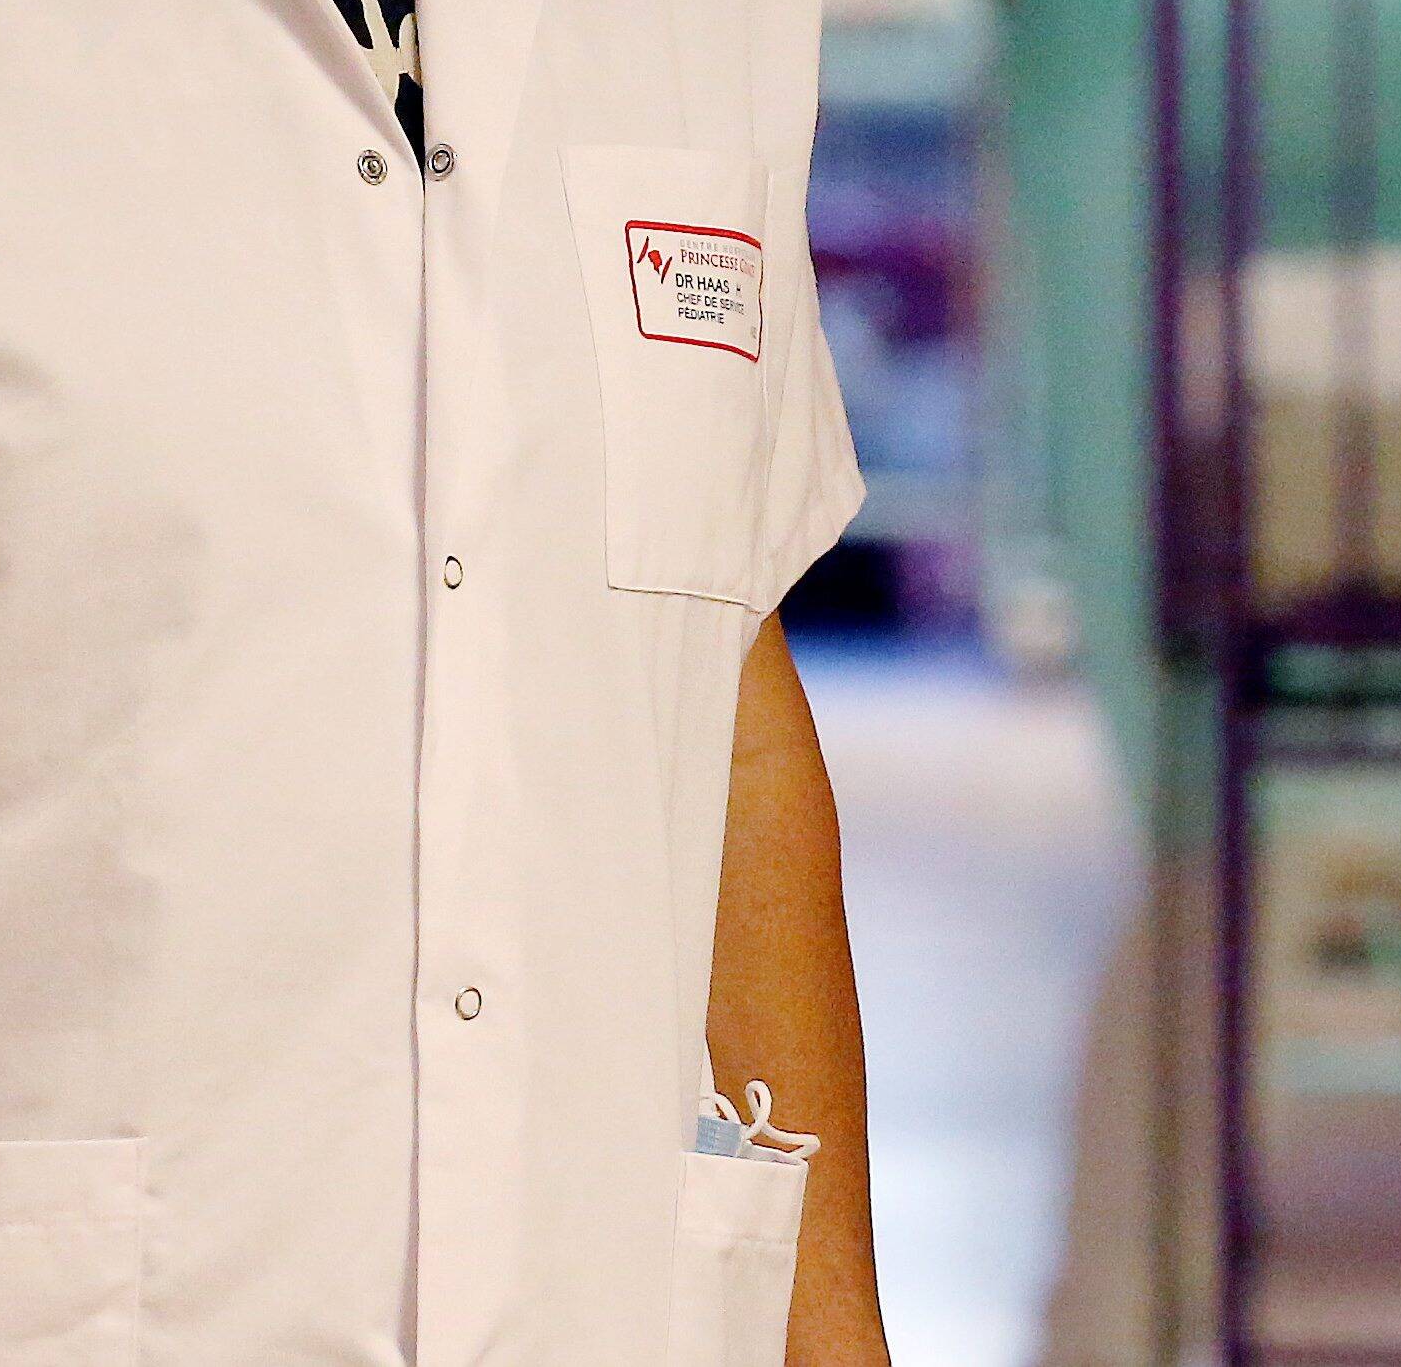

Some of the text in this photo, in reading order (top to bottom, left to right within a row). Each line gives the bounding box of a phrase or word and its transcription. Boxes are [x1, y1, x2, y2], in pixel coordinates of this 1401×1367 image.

[676, 273, 693, 289] DR
[697, 276, 730, 294] HAAS
[677, 292, 701, 305] CHEF
[704, 295, 718, 308] DE
